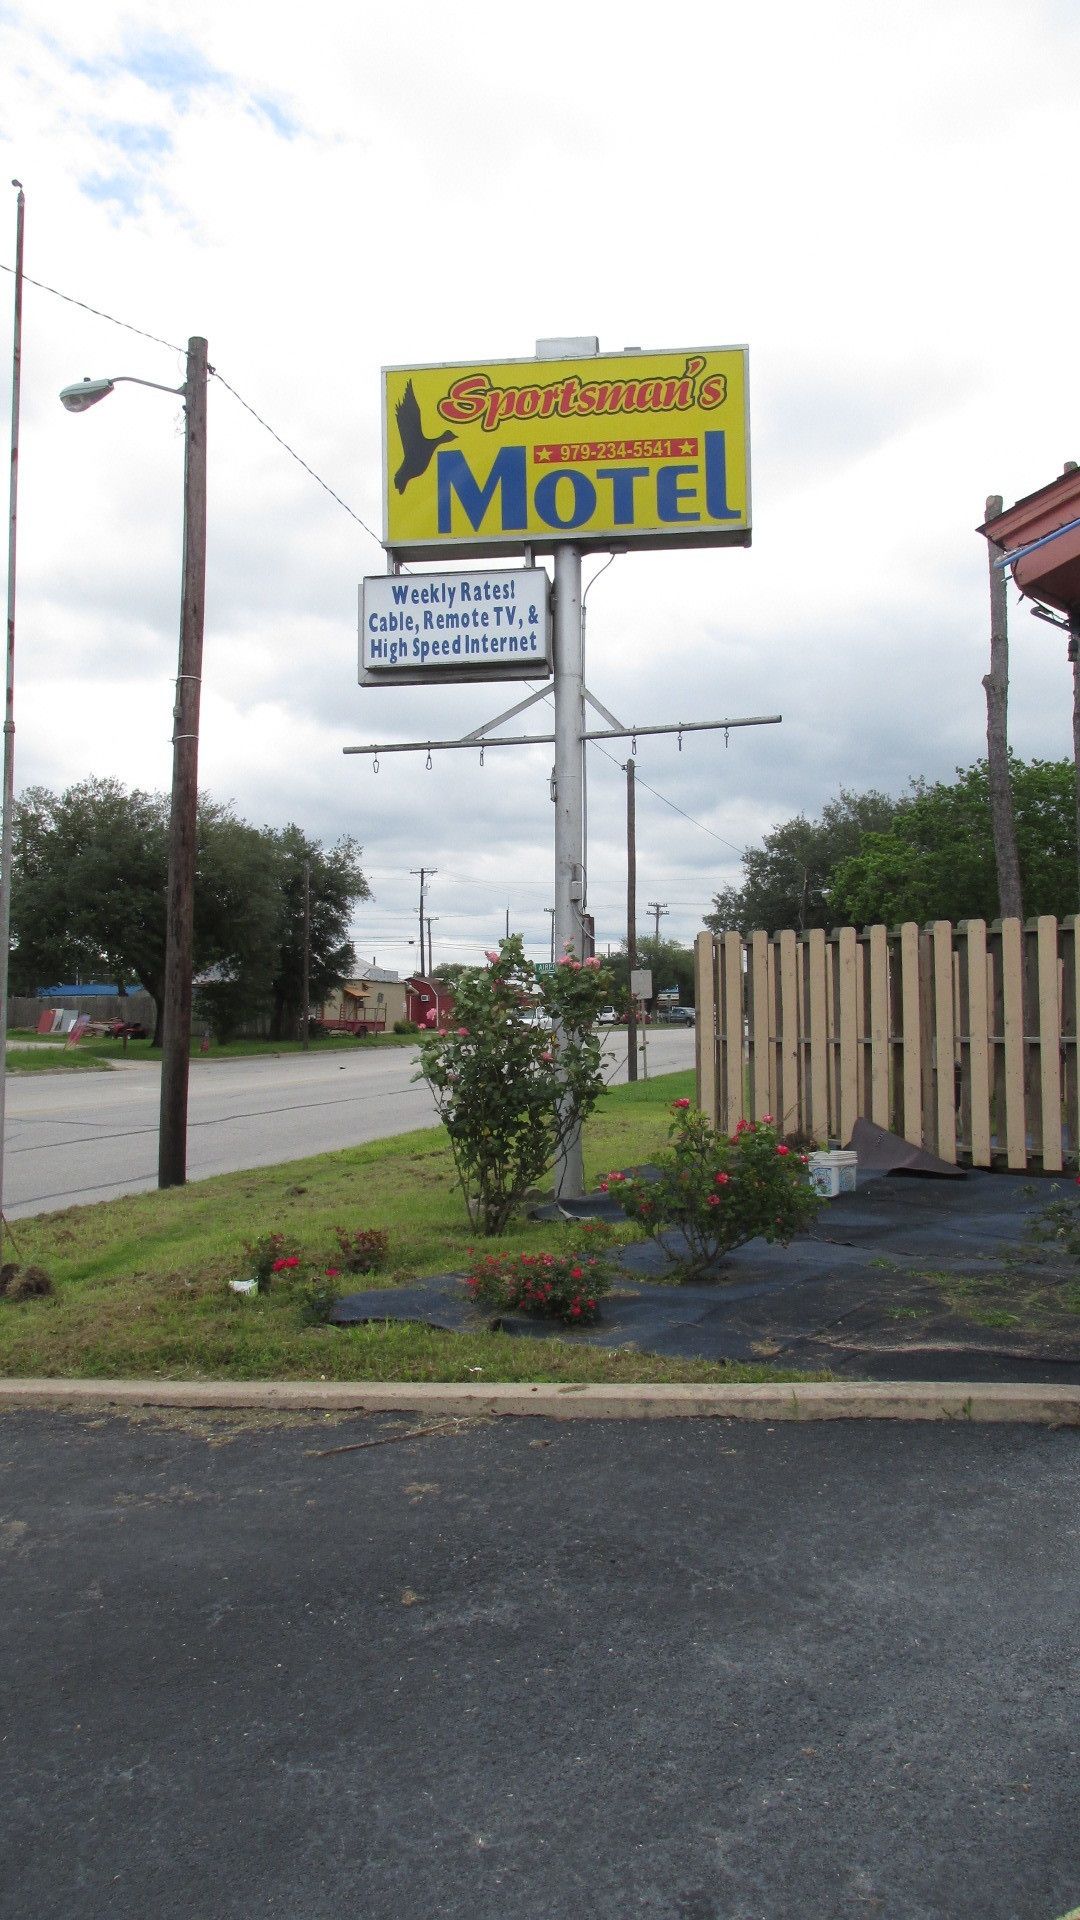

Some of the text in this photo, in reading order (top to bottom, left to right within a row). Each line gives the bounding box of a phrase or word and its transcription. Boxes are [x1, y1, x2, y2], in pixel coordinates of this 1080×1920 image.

[437, 356, 727, 432] Sportsman's
[560, 441, 673, 461] 979-234-5541
[437, 430, 742, 534] MOTEL
[392, 579, 515, 608] Weekly Rates!
[368, 604, 539, 635] Cable, Remote TV, &
[370, 631, 537, 664] High Speed Internet
